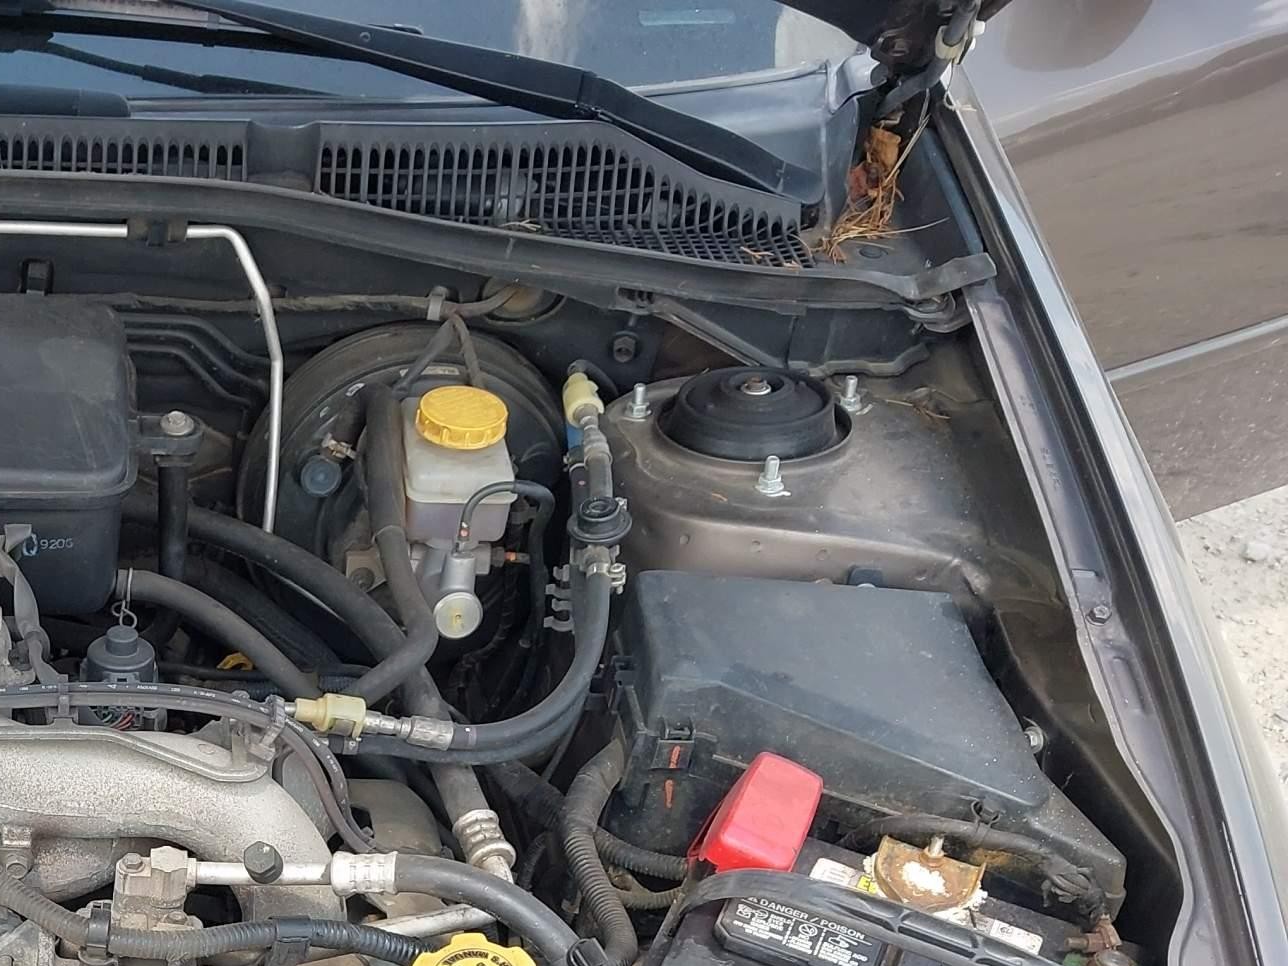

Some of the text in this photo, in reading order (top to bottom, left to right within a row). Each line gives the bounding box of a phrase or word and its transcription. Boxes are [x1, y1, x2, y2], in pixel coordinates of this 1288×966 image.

[759, 898, 809, 921] DANGER
[820, 918, 866, 940] POISON
[442, 950, 489, 966] MANUAL
